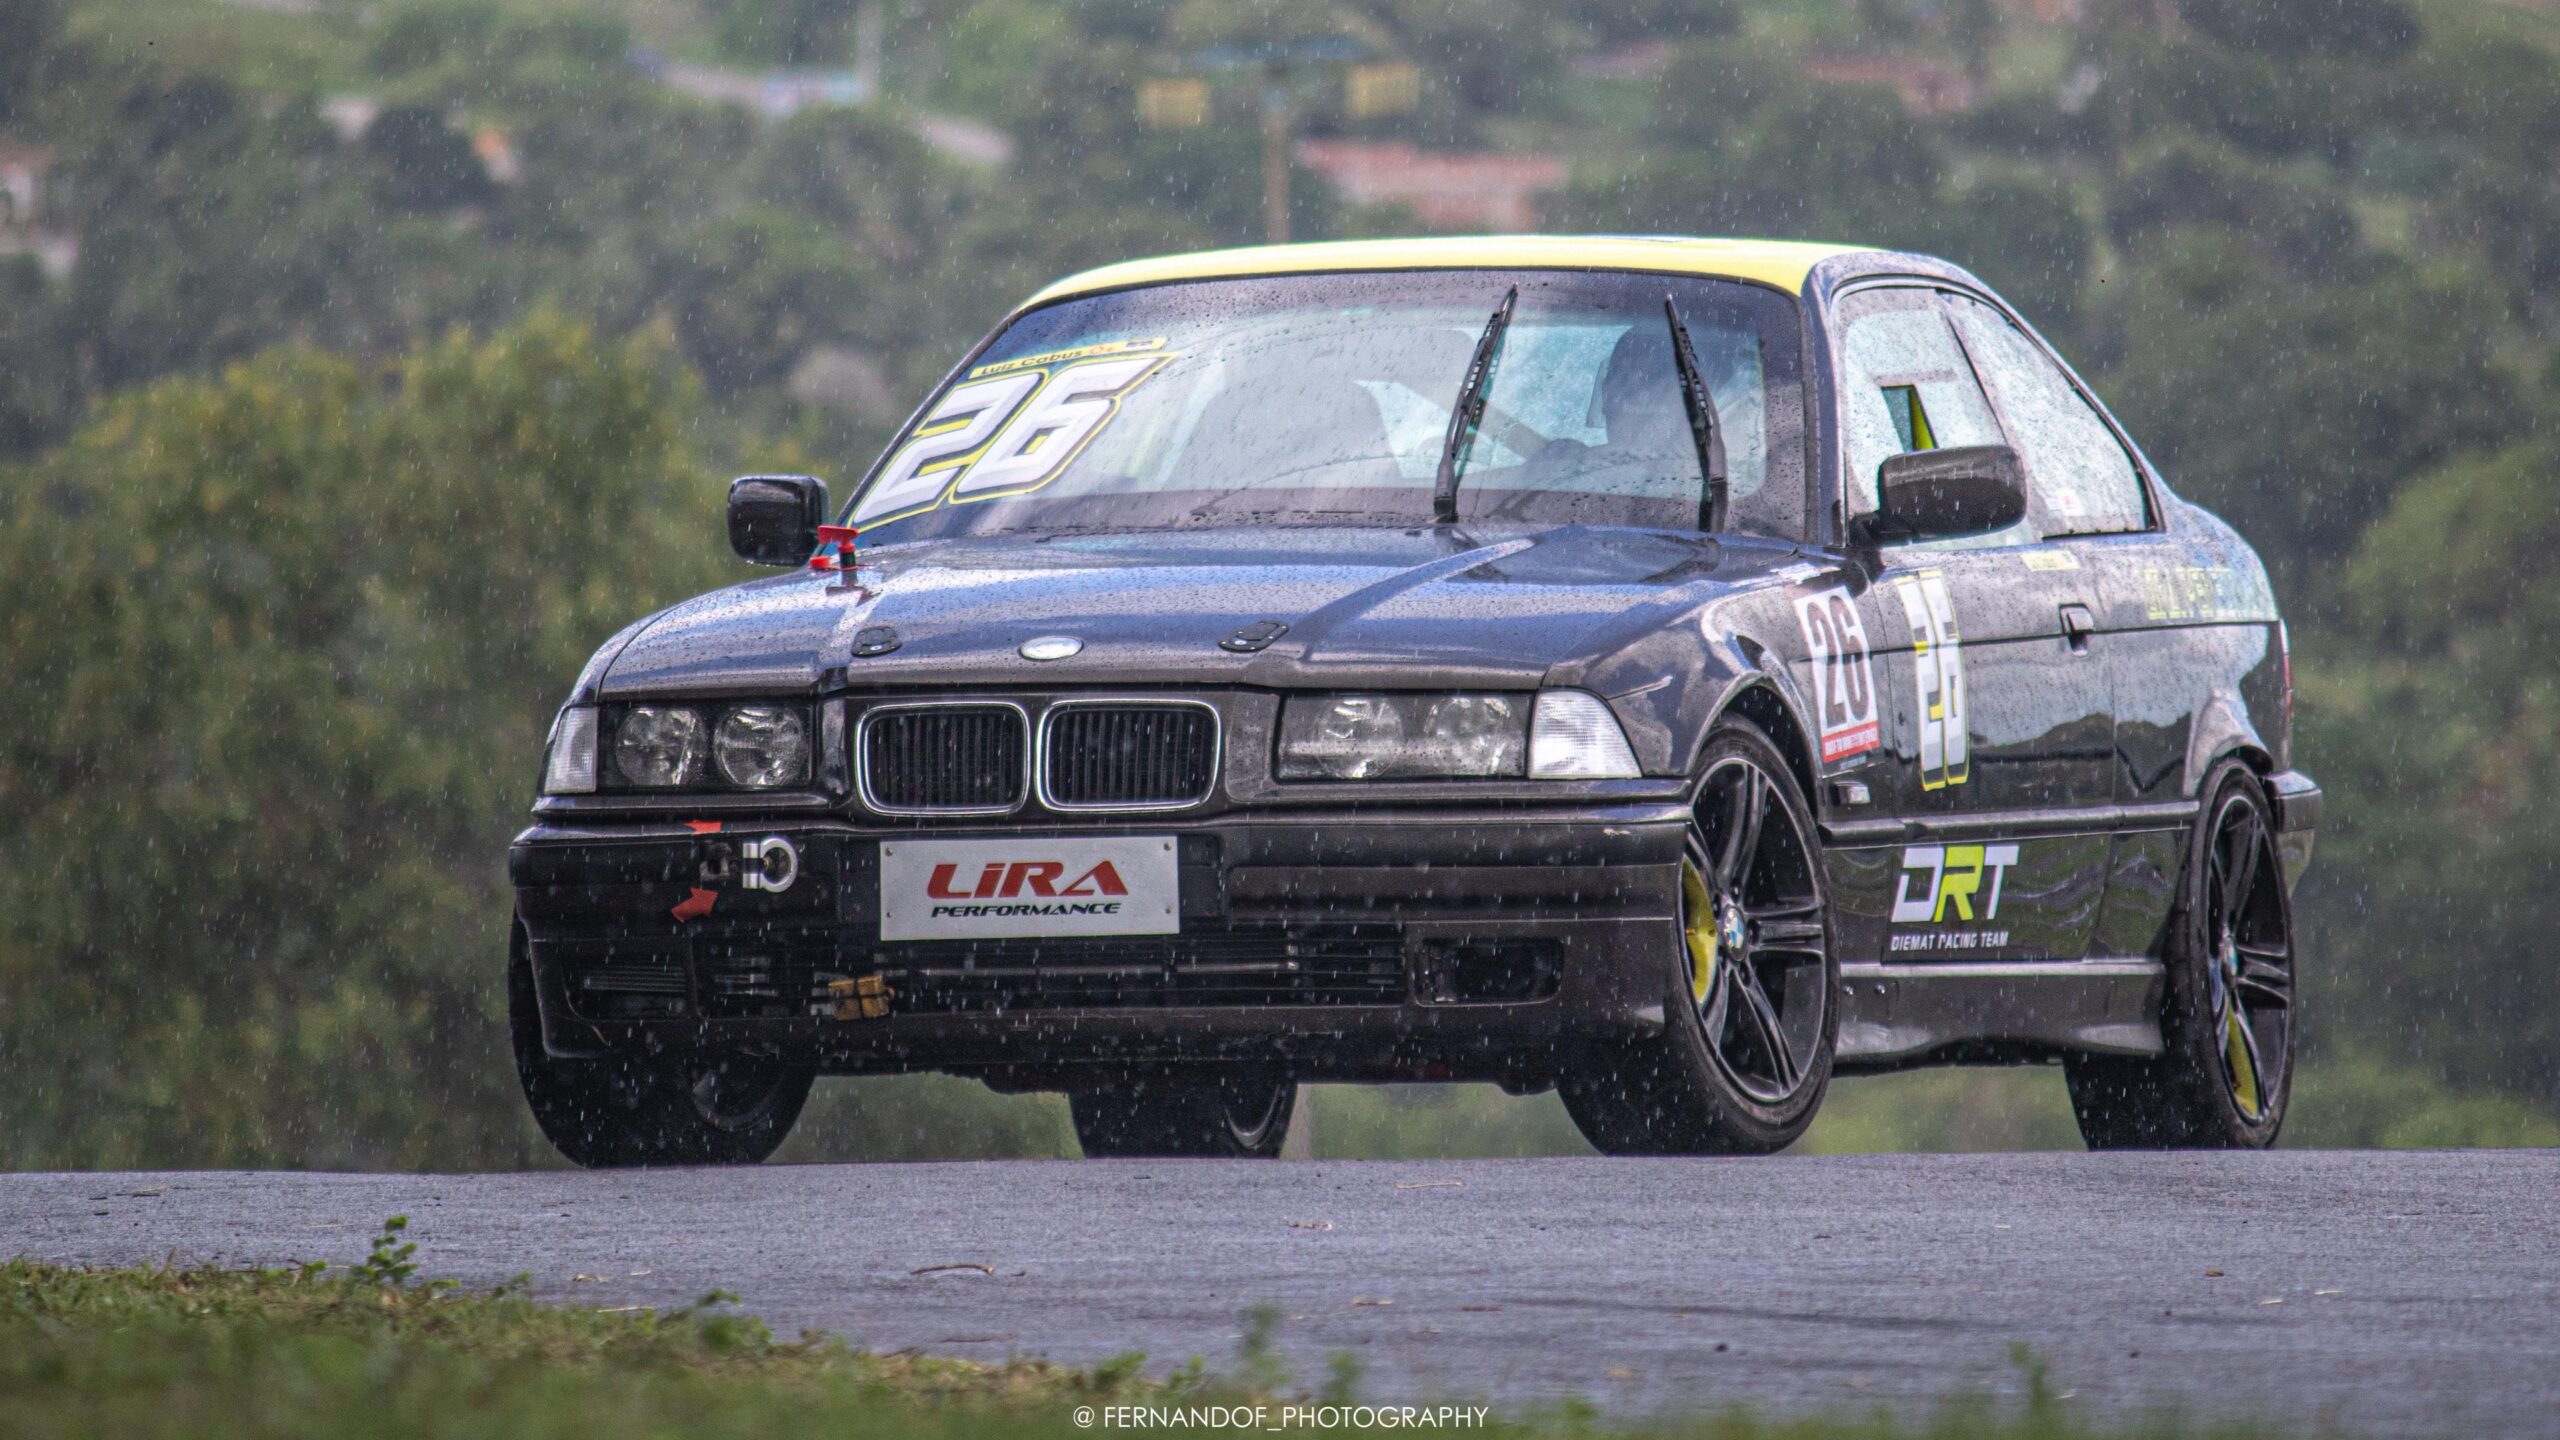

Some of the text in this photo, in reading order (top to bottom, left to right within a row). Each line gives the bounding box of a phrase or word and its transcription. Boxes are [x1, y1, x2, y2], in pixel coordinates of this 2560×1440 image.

[1020, 349, 1083, 367] Cabus
[850, 355, 1172, 528] 26
[1806, 595, 1870, 729] 26
[1895, 569, 1970, 791] 26
[931, 902, 1122, 918] PERFORMANCE
[1891, 845, 2020, 923] DRT
[1891, 934, 1934, 951] DIEMAT
[1981, 931, 2008, 947] TEAM
